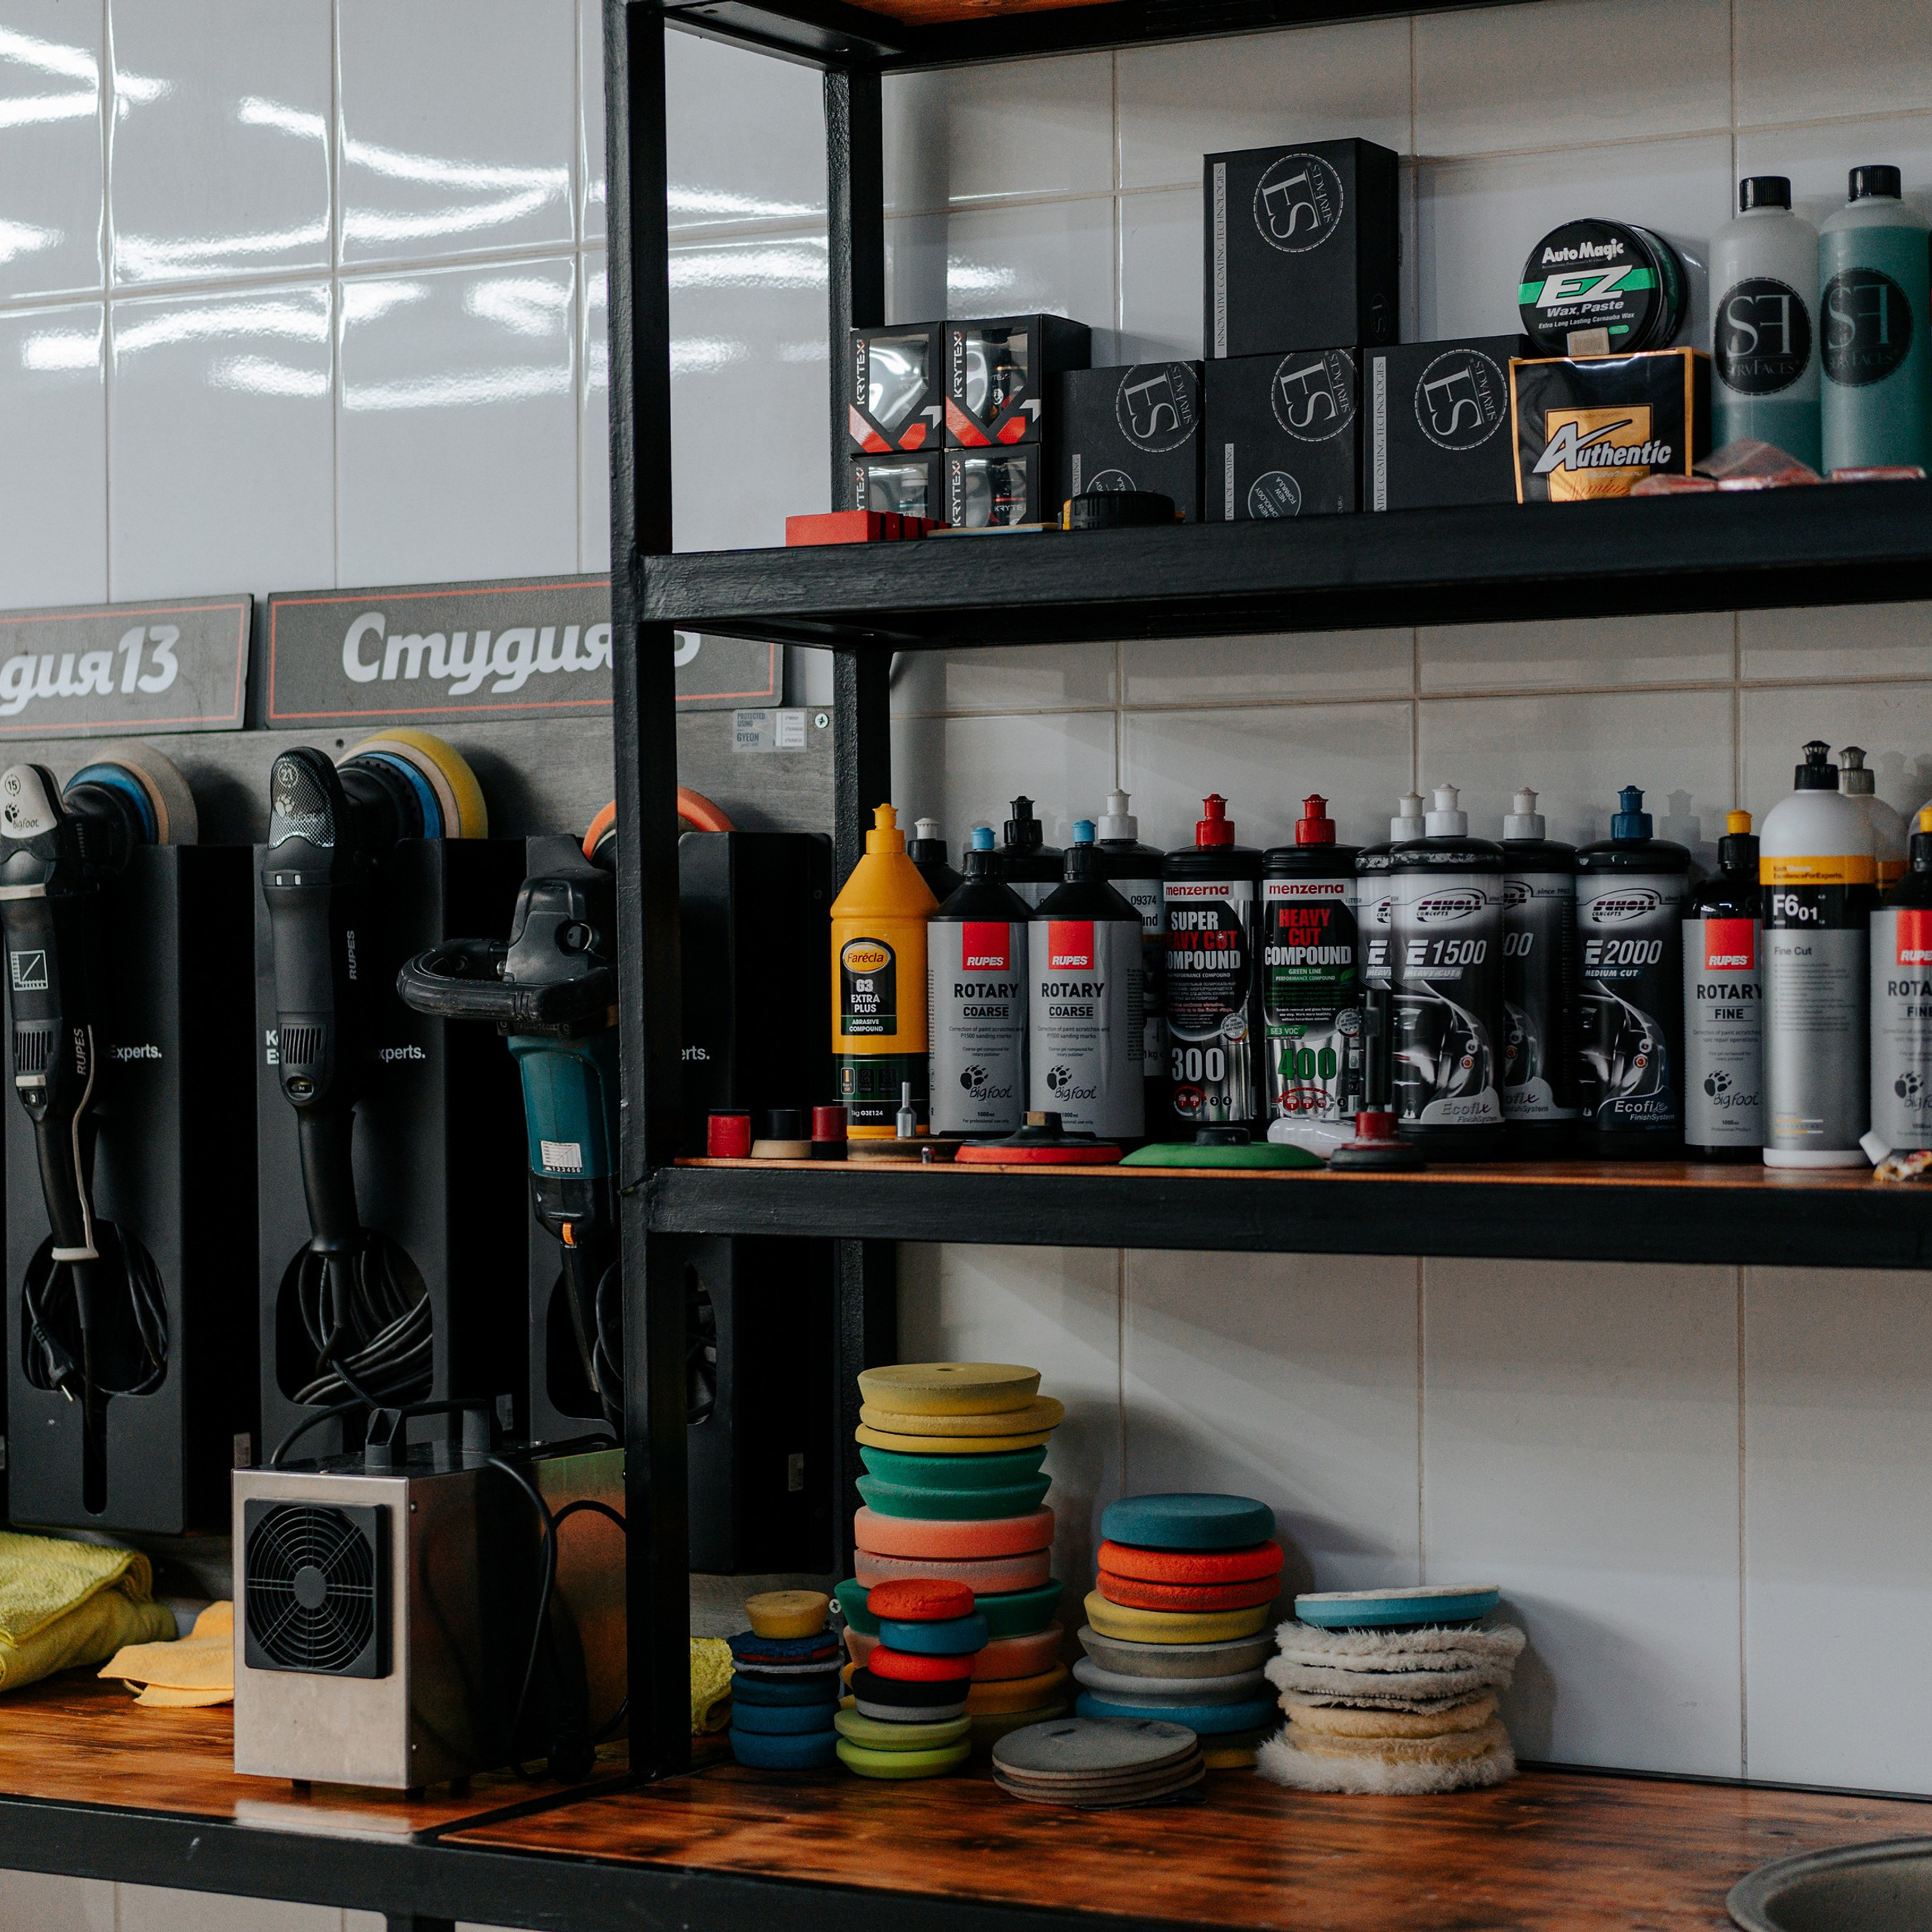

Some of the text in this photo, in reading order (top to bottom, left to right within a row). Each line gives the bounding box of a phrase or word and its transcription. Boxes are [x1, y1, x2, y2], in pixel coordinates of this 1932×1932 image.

[1310, 164, 1334, 224] SERVFACES
[1536, 265, 1633, 309] EZ
[1547, 300, 1624, 318] Wax Paste
[1554, 320, 1569, 328] Long
[1570, 317, 1592, 326] Lasting
[1592, 314, 1620, 323] Carnauba
[1621, 312, 1635, 320] Wax
[857, 338, 866, 405] KRYTEX
[953, 331, 963, 398] KRYTEX
[1328, 352, 1351, 414] SERVFACES
[1474, 360, 1497, 422] SERVFACES
[1171, 365, 1193, 425] SERVFACES
[1374, 362, 1385, 438] TECHNOLOGIES
[1532, 419, 1672, 474] Authentic
[1376, 438, 1385, 484] COATING
[952, 460, 961, 527] KRYTEX
[342, 611, 701, 697] Студия
[737, 732, 759, 742] GYEON
[8, 780, 18, 791] 15
[1165, 885, 1229, 896] menzerna
[1269, 884, 1345, 895] menzerna
[1171, 911, 1219, 931] SUPER
[1278, 908, 1331, 928] HEAVY
[1166, 930, 1238, 951] EAVY CUT
[1287, 928, 1321, 946] CUT
[347, 930, 357, 980] RUPES
[847, 952, 884, 963] Farécla
[1052, 955, 1088, 965] RUPES
[1265, 946, 1352, 966] COMPOUND
[1433, 940, 1487, 965] 1500
[1604, 939, 1663, 965] 2000
[1774, 946, 1812, 955] Fine Cut
[967, 956, 1004, 966] RUPES
[1166, 950, 1241, 971] OMPOUND
[1709, 955, 1748, 966] RUPES
[1586, 969, 1639, 977] MEDIUM CUT
[856, 978, 874, 992] G3
[954, 983, 1020, 998] ROTARY
[1041, 983, 1106, 998] ROTARY
[851, 994, 881, 1003] EXTRA
[854, 1004, 877, 1013] PLUS
[963, 1006, 1010, 1017] COARSE
[1049, 1006, 1094, 1017] COARSE
[1715, 1008, 1744, 1020] FINE
[74, 1027, 87, 1075] RUPES
[1172, 1048, 1226, 1082] 300
[1278, 1047, 1337, 1081] 400
[1441, 1102, 1492, 1115] Ecofix
[1614, 1100, 1668, 1114] Ecofix
